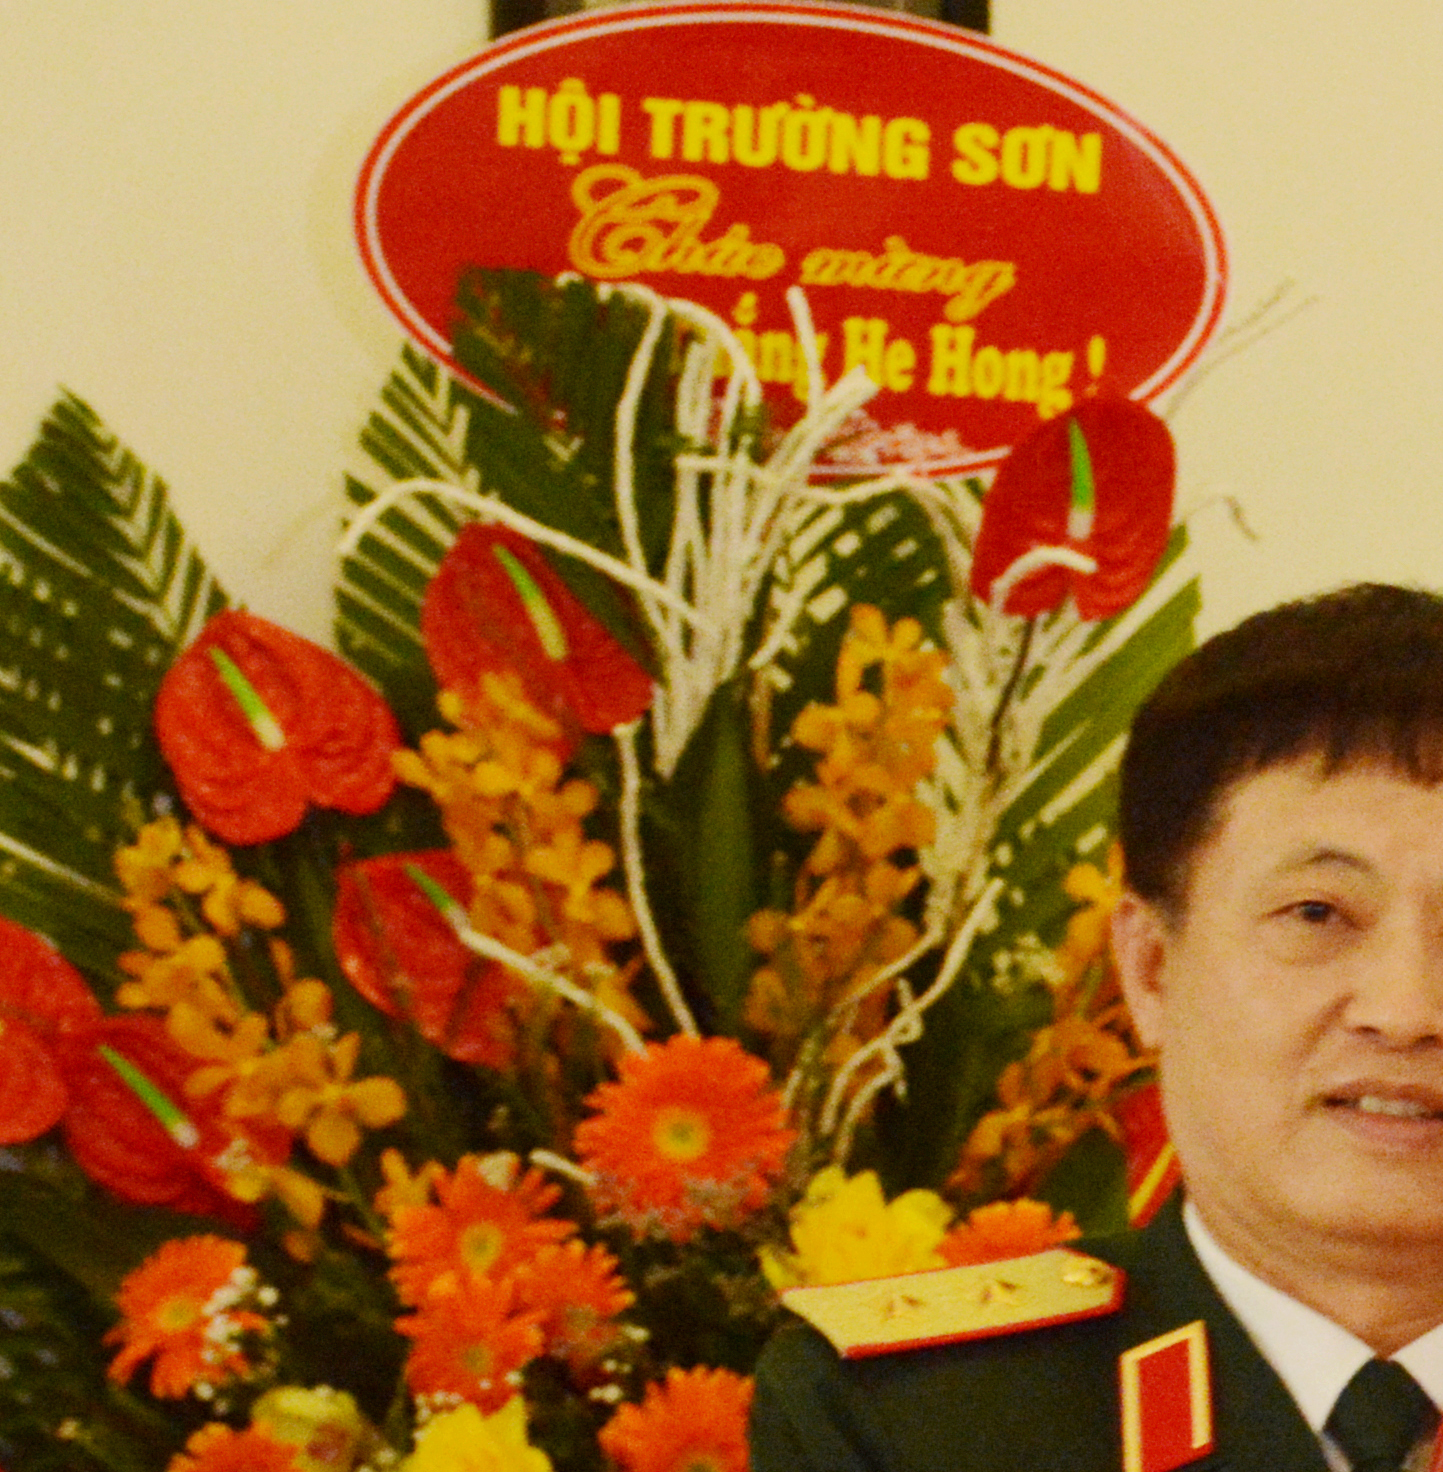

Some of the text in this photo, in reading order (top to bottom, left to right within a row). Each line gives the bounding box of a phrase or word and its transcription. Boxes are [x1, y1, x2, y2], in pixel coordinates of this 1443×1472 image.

[497, 77, 1102, 195] HỘI TRƯỜNG SƠN
[800, 234, 1017, 322] mừng
